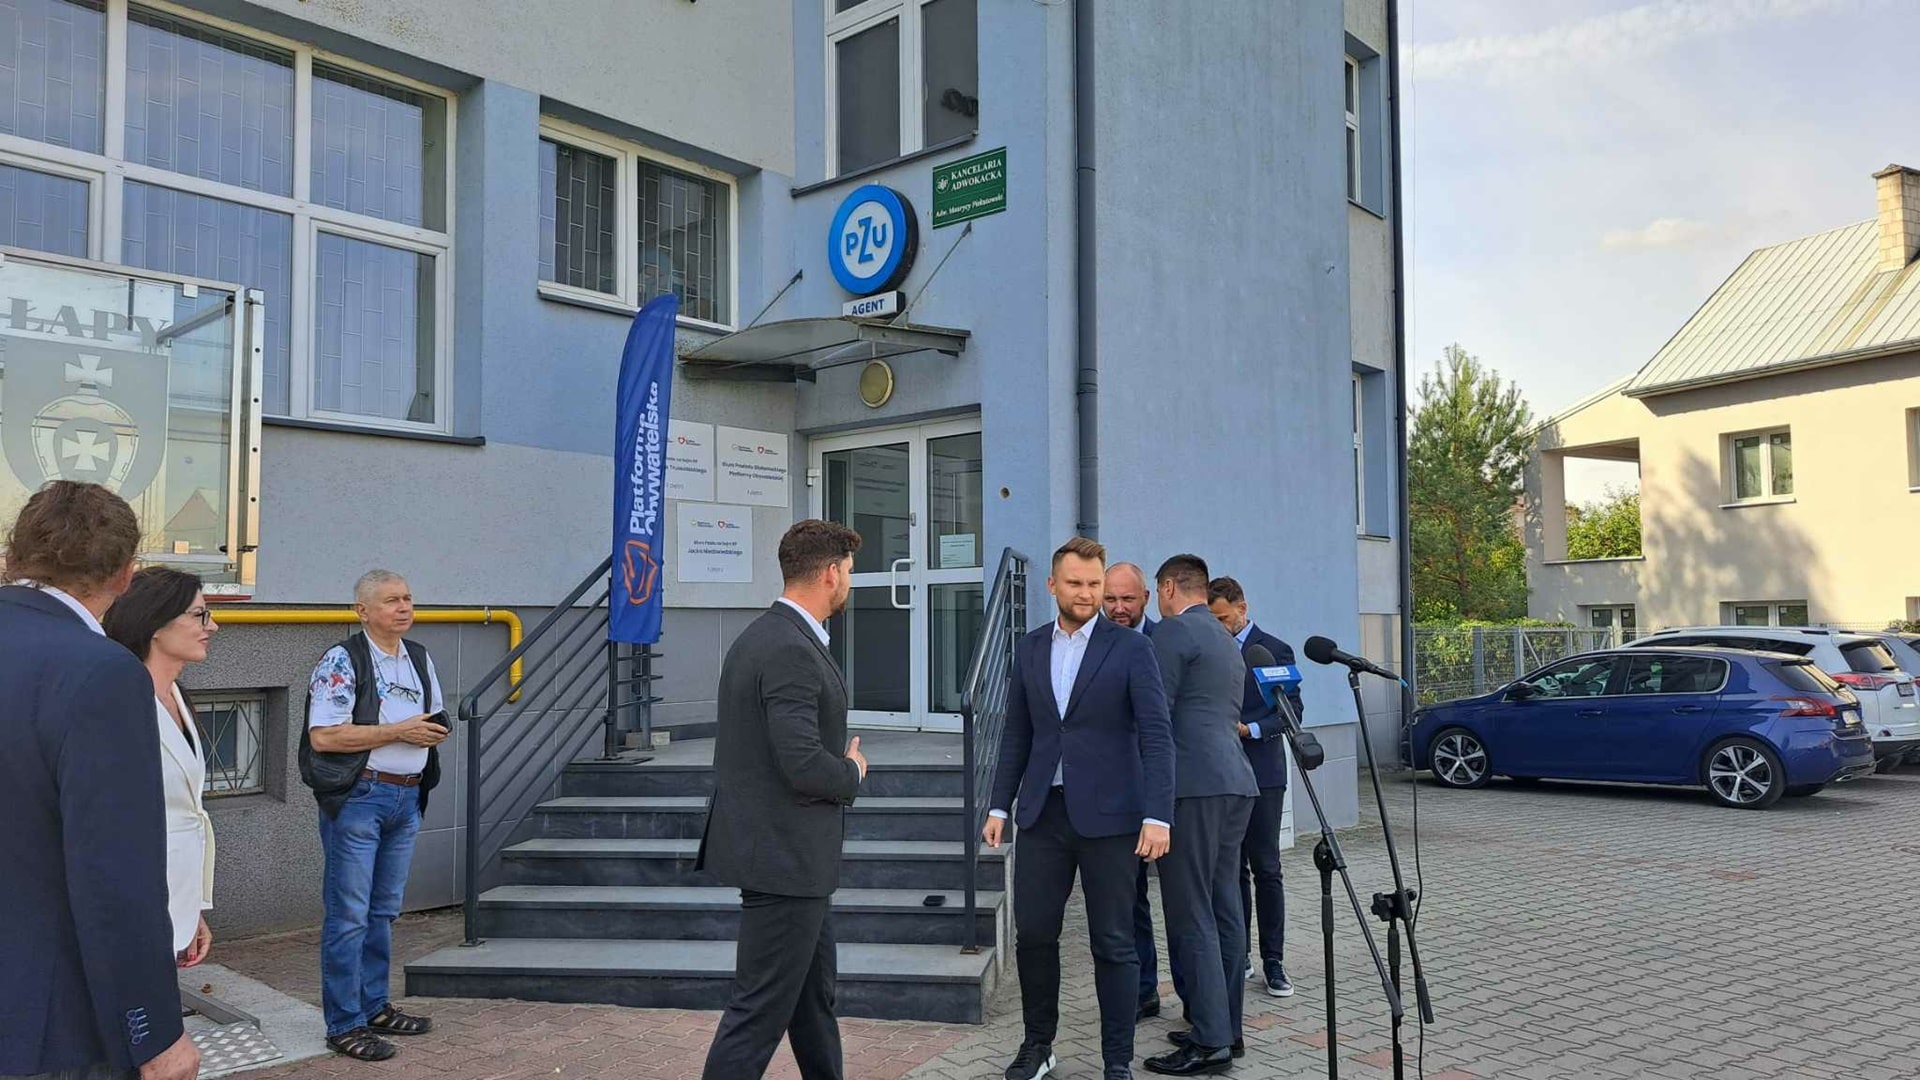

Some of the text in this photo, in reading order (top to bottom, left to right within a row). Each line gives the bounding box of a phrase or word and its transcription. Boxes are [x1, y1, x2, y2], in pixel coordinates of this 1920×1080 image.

[951, 159, 1002, 180] KANCELARIA
[951, 170, 1002, 192] ADWOKACKA
[845, 216, 887, 264] PZU
[851, 299, 885, 316] AGENT
[7, 297, 170, 354] ŁAPY
